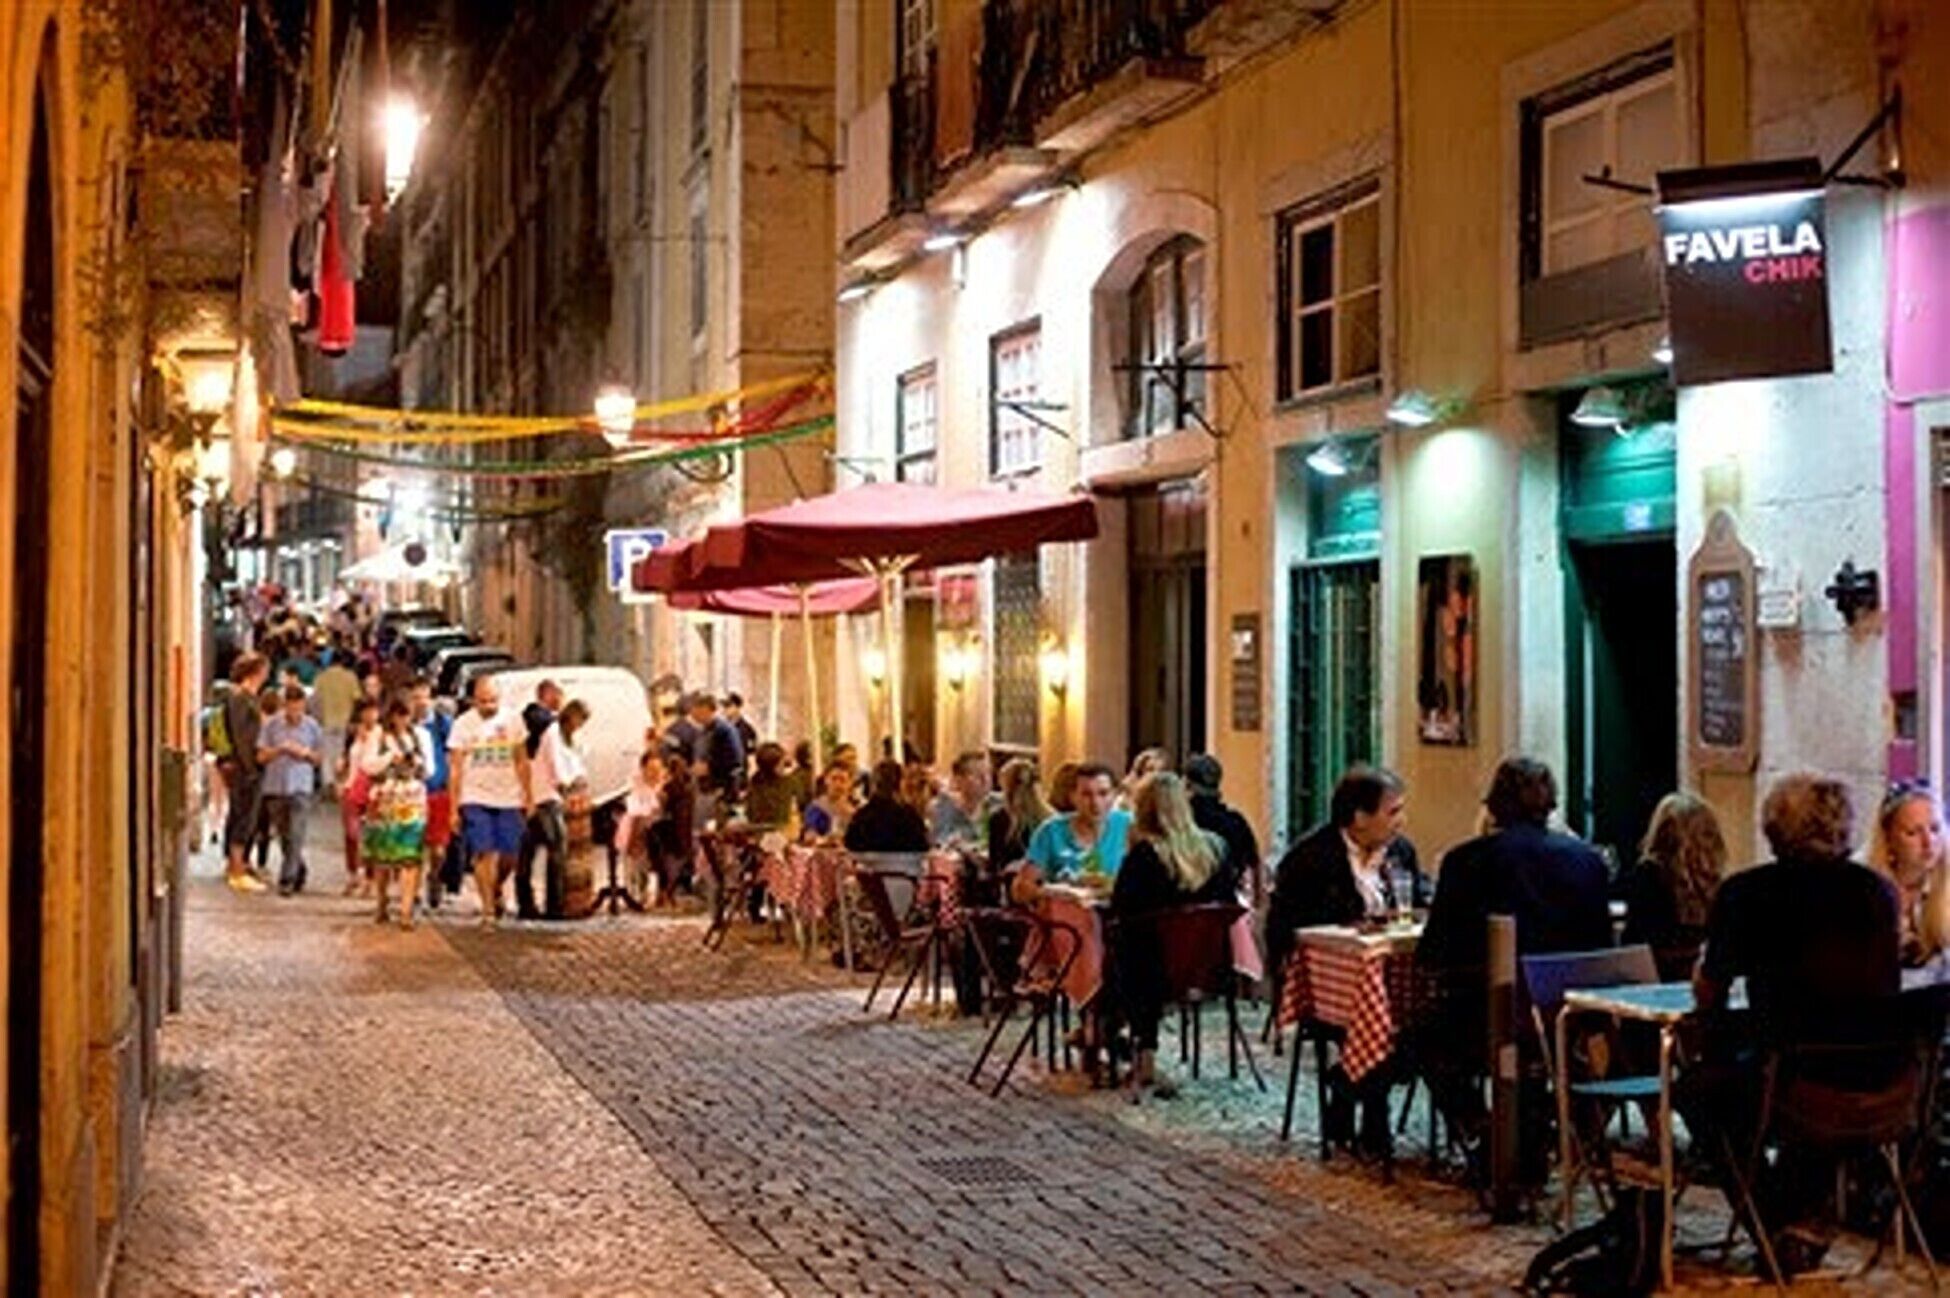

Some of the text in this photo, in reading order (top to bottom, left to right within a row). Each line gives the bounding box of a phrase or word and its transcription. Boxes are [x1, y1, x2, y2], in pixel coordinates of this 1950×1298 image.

[1664, 221, 1822, 266] FAVELA
[1744, 255, 1823, 283] CHIK
[621, 538, 652, 588] P
